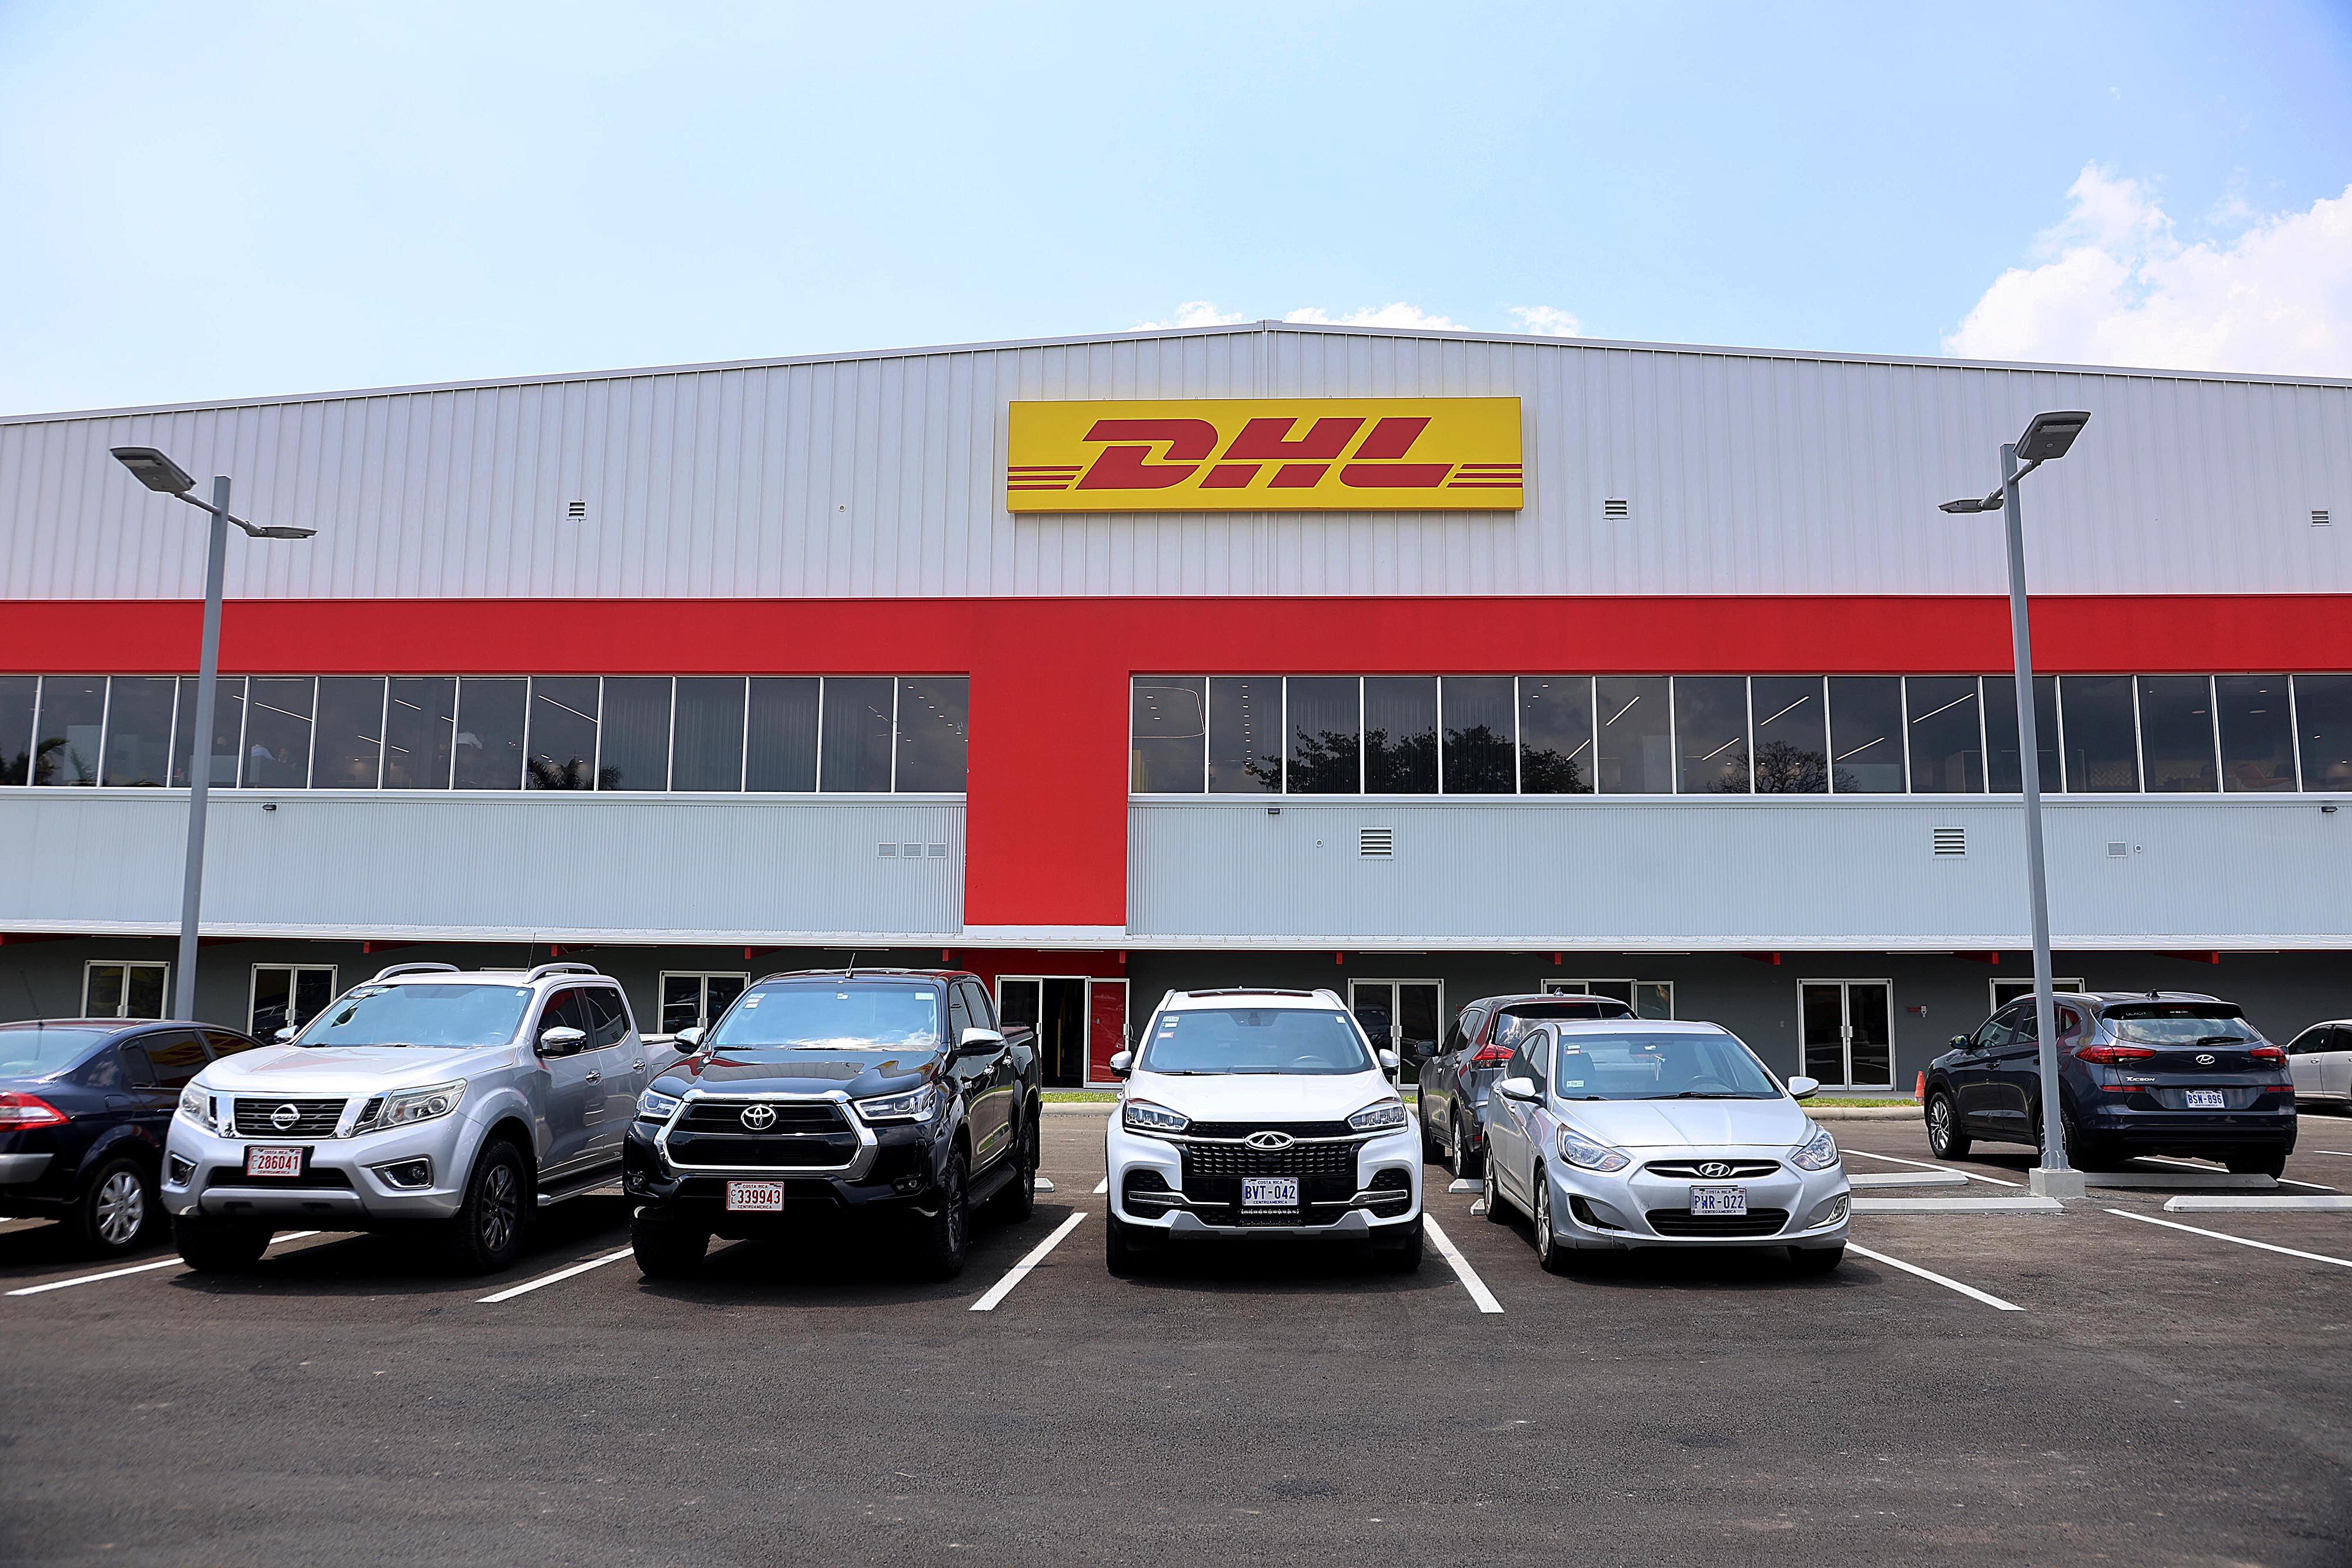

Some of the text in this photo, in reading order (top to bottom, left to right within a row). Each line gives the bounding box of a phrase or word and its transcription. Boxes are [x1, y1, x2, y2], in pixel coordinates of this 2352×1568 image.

[1074, 417, 1454, 490] DHL
[2187, 1094, 2222, 1104] BSN-896
[258, 1155, 299, 1170] 286041
[737, 1189, 780, 1204] 339943
[1245, 1185, 1295, 1199] BVT-042
[1695, 1195, 1744, 1209] PWR-022
